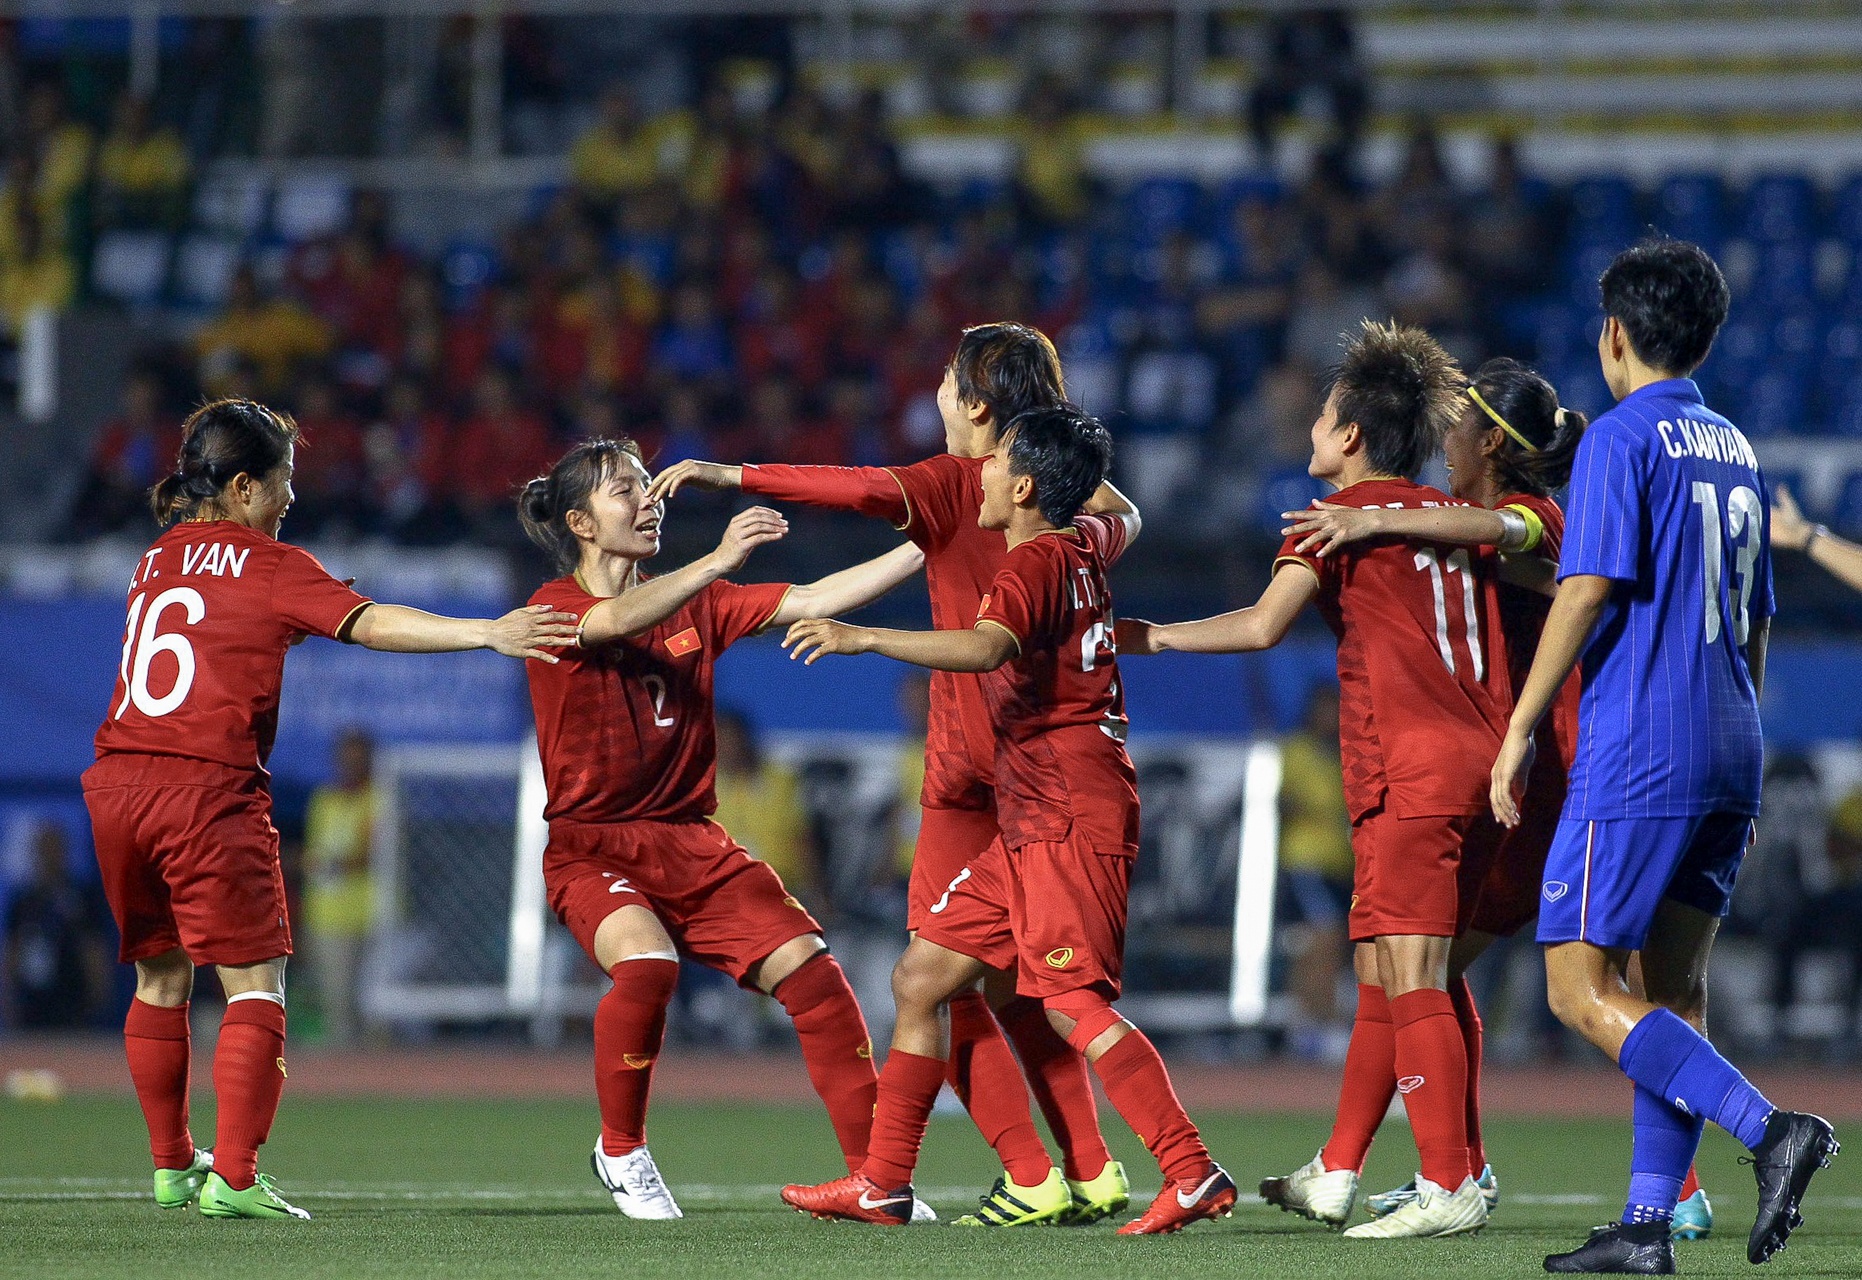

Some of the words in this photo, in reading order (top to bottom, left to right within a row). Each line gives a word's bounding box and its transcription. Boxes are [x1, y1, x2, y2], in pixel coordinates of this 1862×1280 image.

[127, 547, 163, 595] .T.
[181, 542, 250, 578] VAN
[1692, 481, 1762, 646] 13
[114, 586, 206, 721] 16
[1413, 547, 1483, 682] 11
[641, 674, 674, 727] 2
[601, 871, 637, 894] 2
